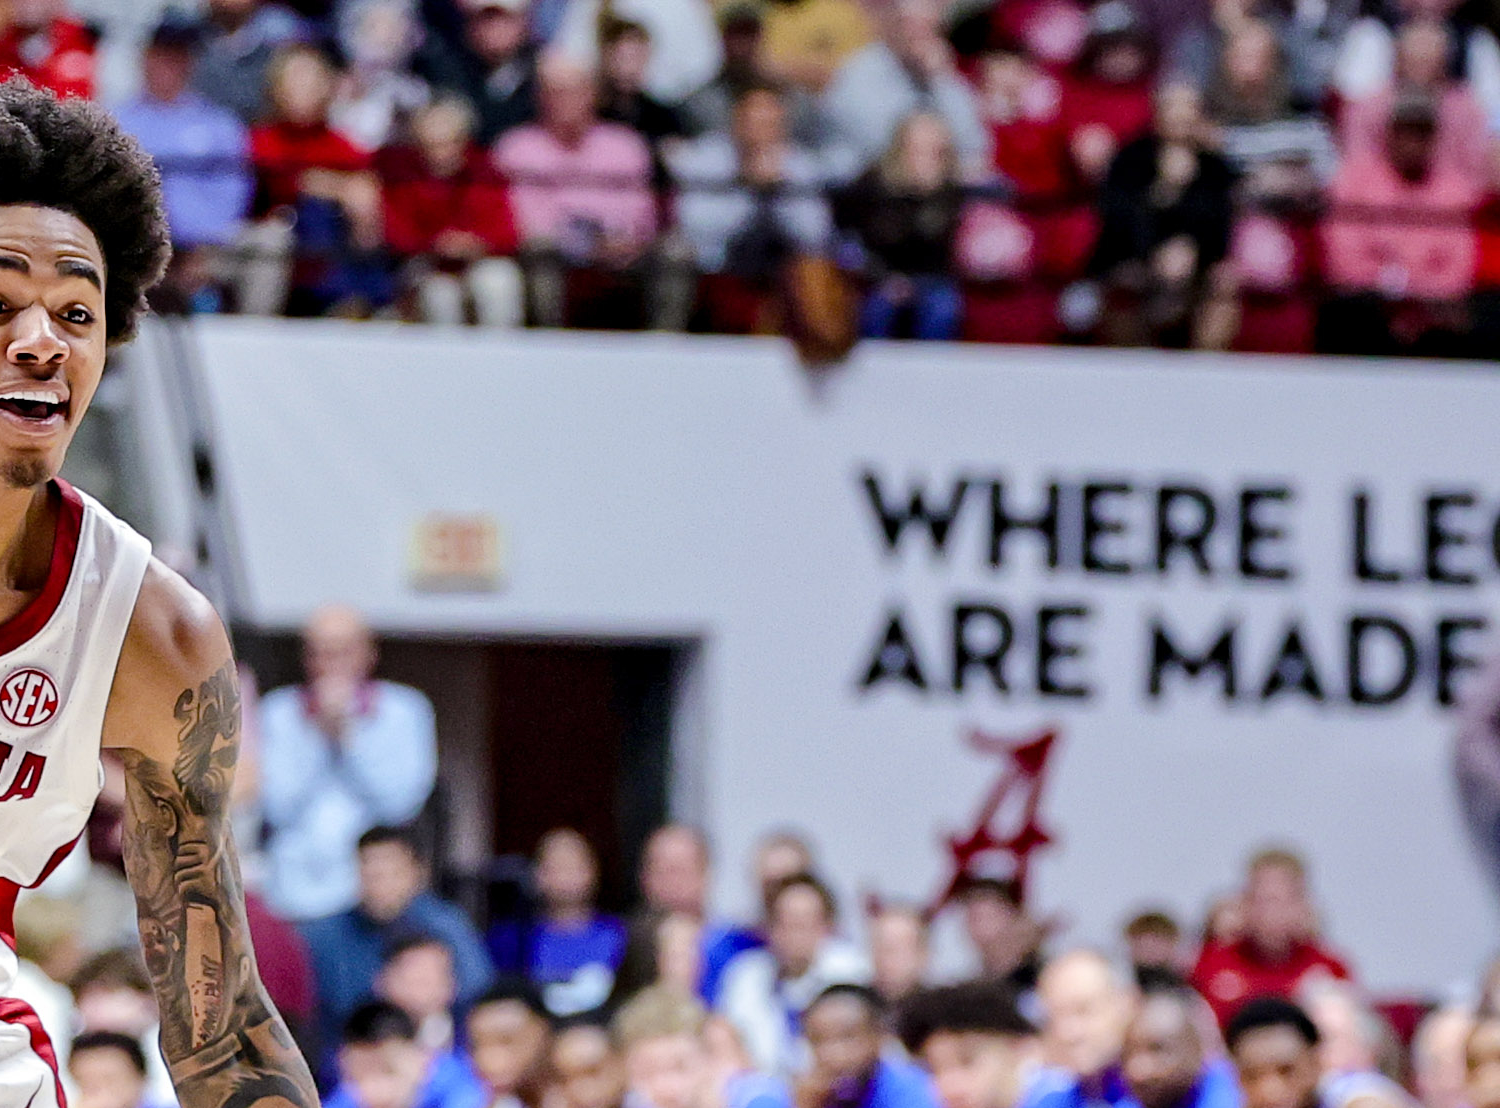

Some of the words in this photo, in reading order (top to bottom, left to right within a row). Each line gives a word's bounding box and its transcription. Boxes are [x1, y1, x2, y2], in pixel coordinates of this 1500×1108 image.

[860, 470, 1293, 580] WHERE
[1352, 490, 1500, 584] LE
[0, 670, 57, 727] SEC
[860, 603, 1091, 699] ARE
[1145, 614, 1487, 706] MADE
